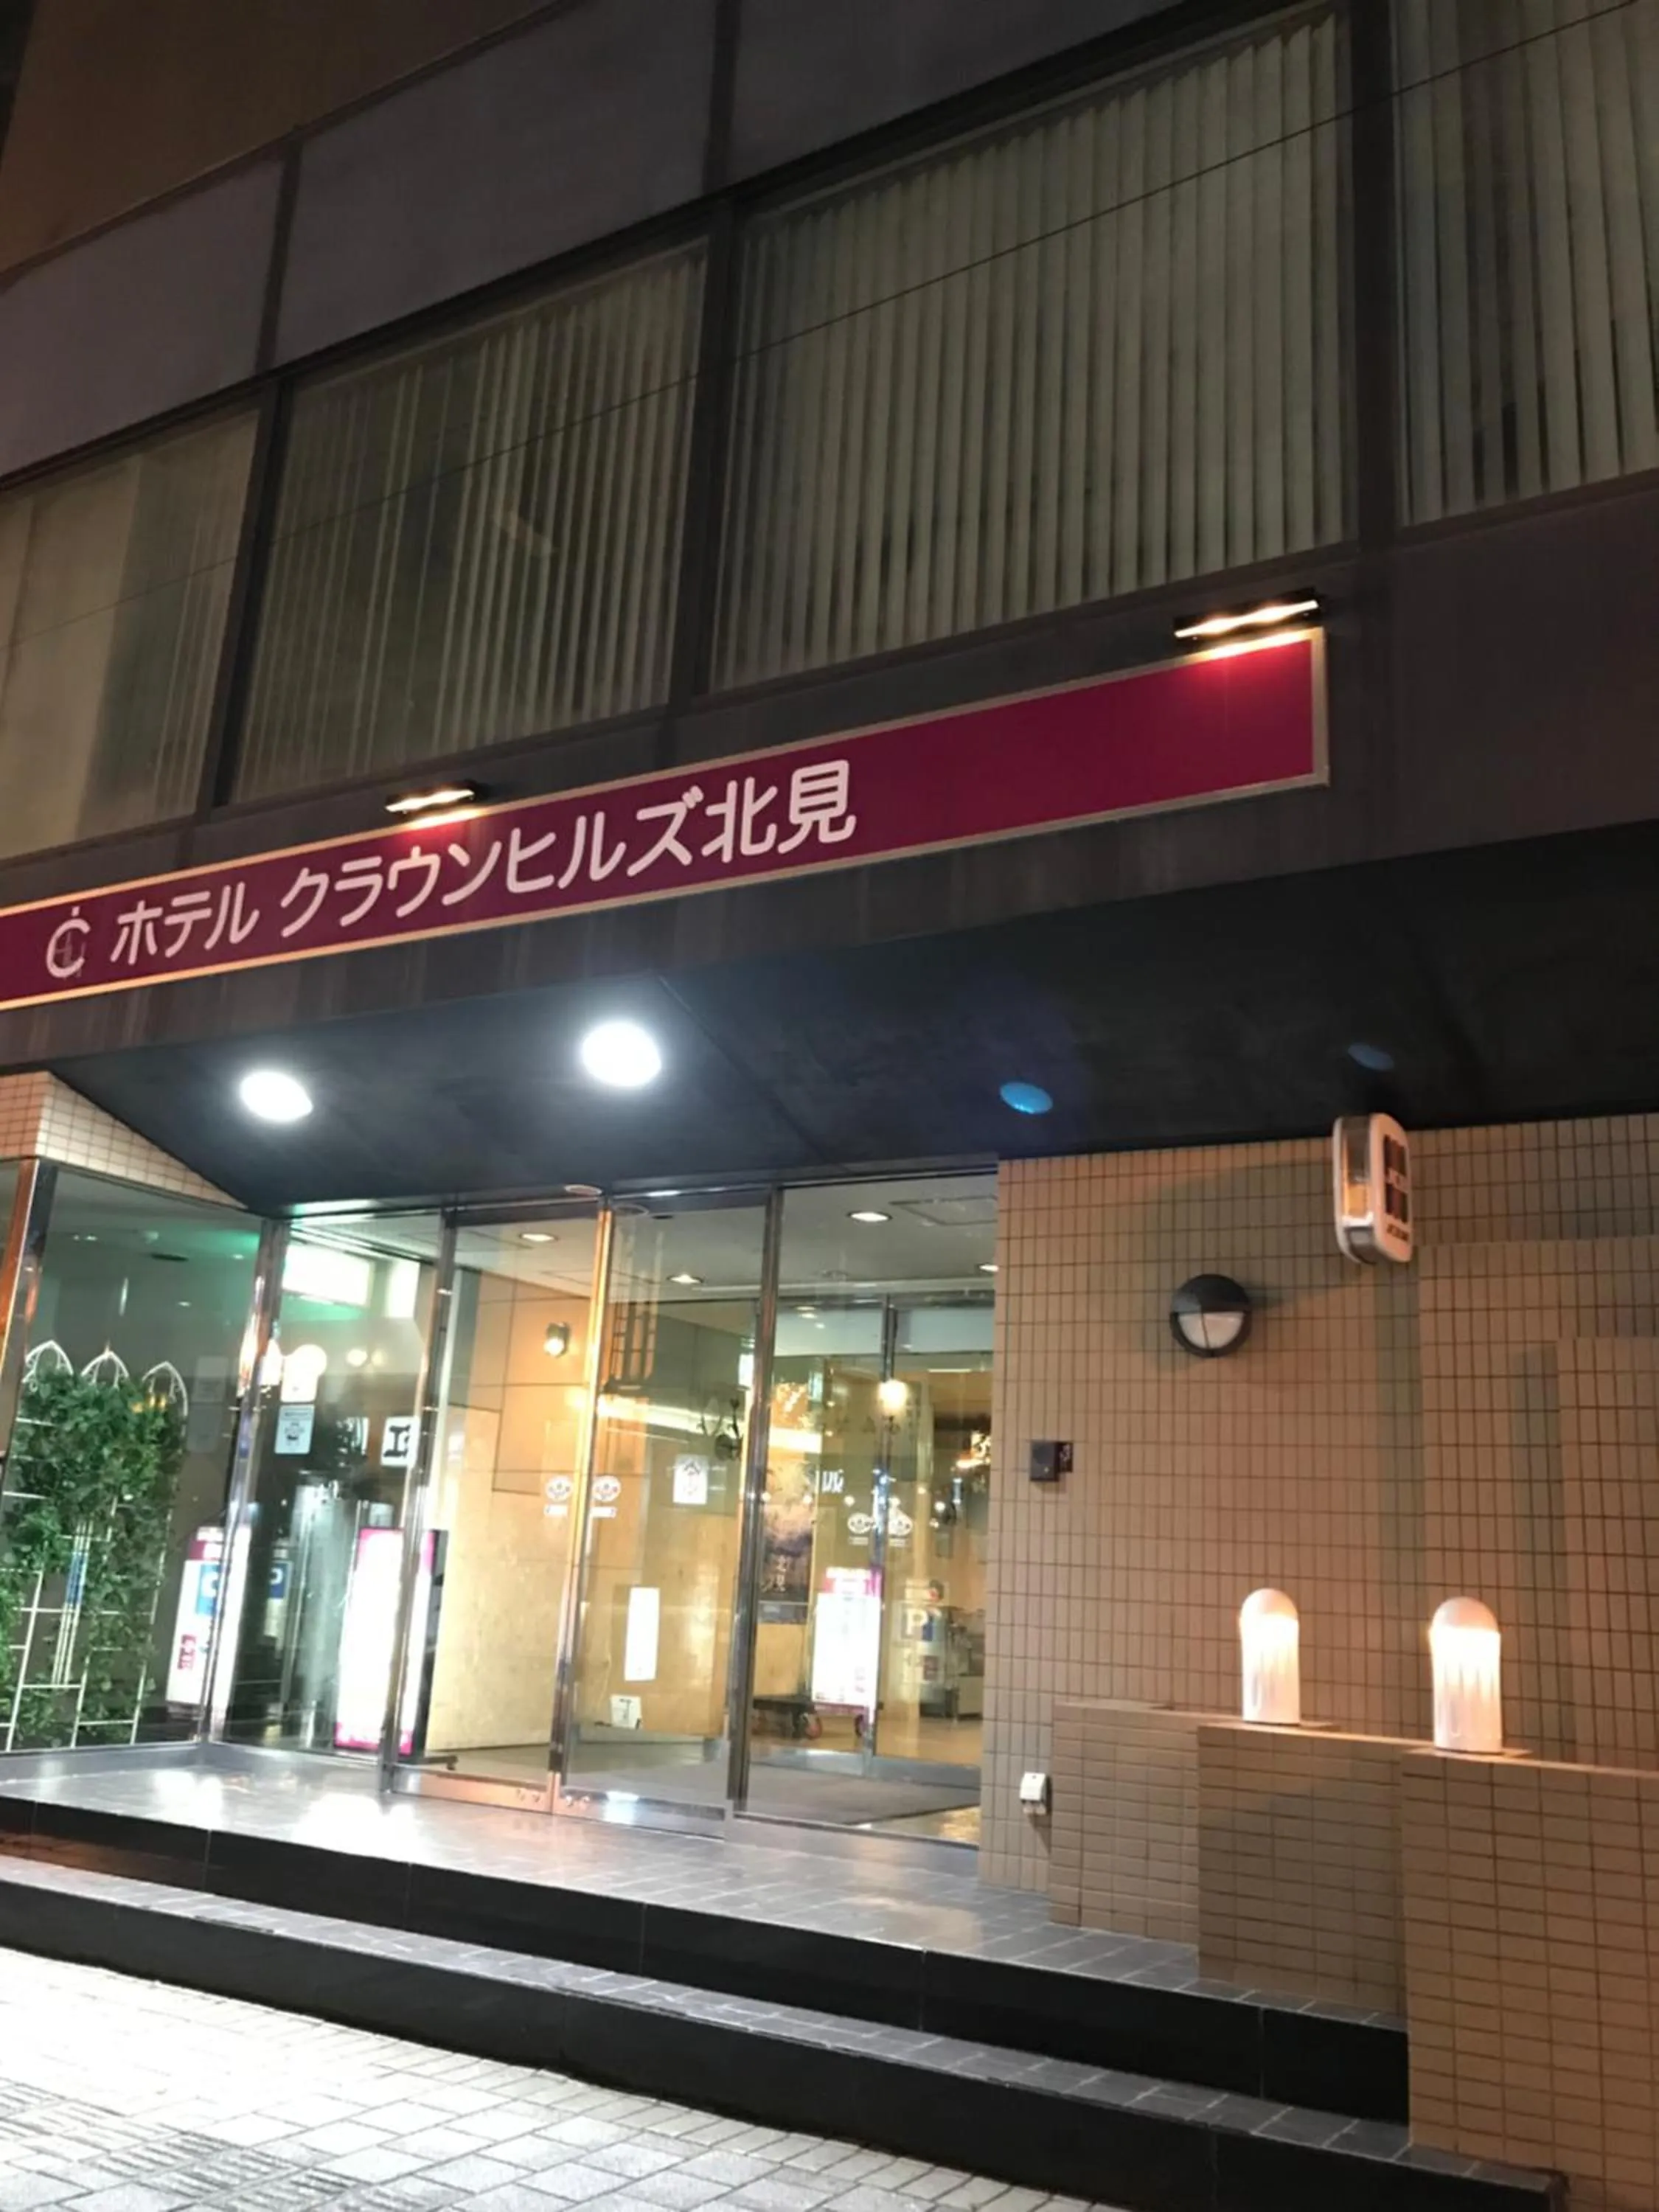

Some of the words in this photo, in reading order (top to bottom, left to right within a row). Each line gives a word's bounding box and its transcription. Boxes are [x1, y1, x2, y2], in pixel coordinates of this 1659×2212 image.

[111, 882, 259, 965] ホテル
[281, 760, 857, 937] クラウンヒルズ北見
